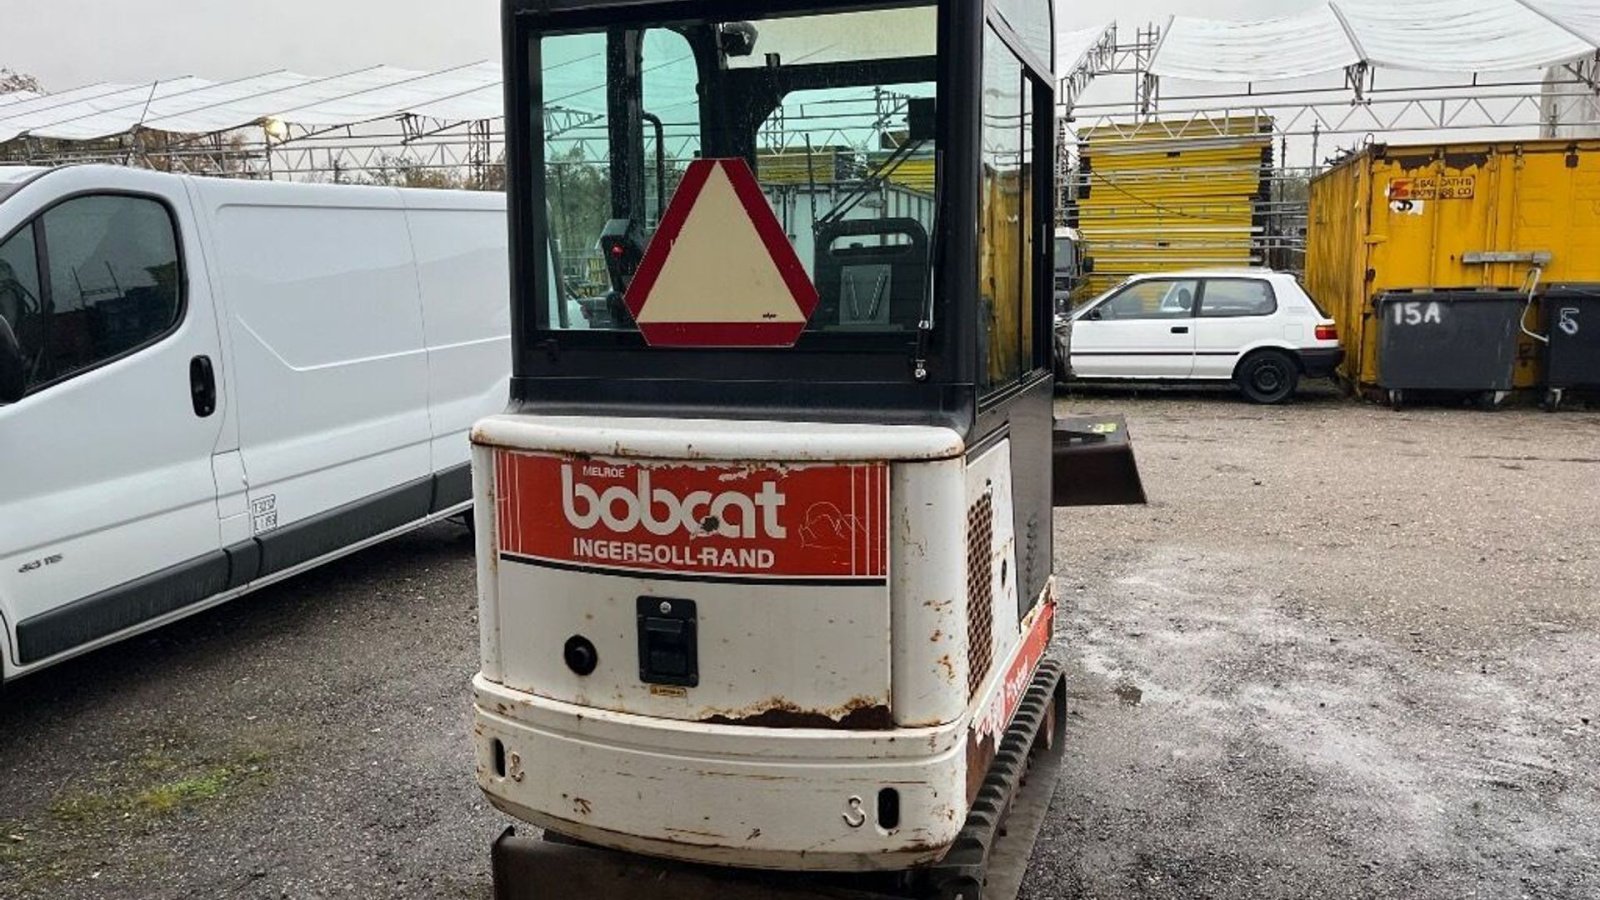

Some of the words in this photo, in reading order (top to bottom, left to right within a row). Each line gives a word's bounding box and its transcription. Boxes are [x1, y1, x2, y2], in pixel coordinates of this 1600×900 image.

[1393, 302, 1441, 325] 15A
[583, 466, 625, 478] MELROE
[561, 464, 787, 539] bobcat
[573, 538, 775, 568] INGERSOLL-RAND
